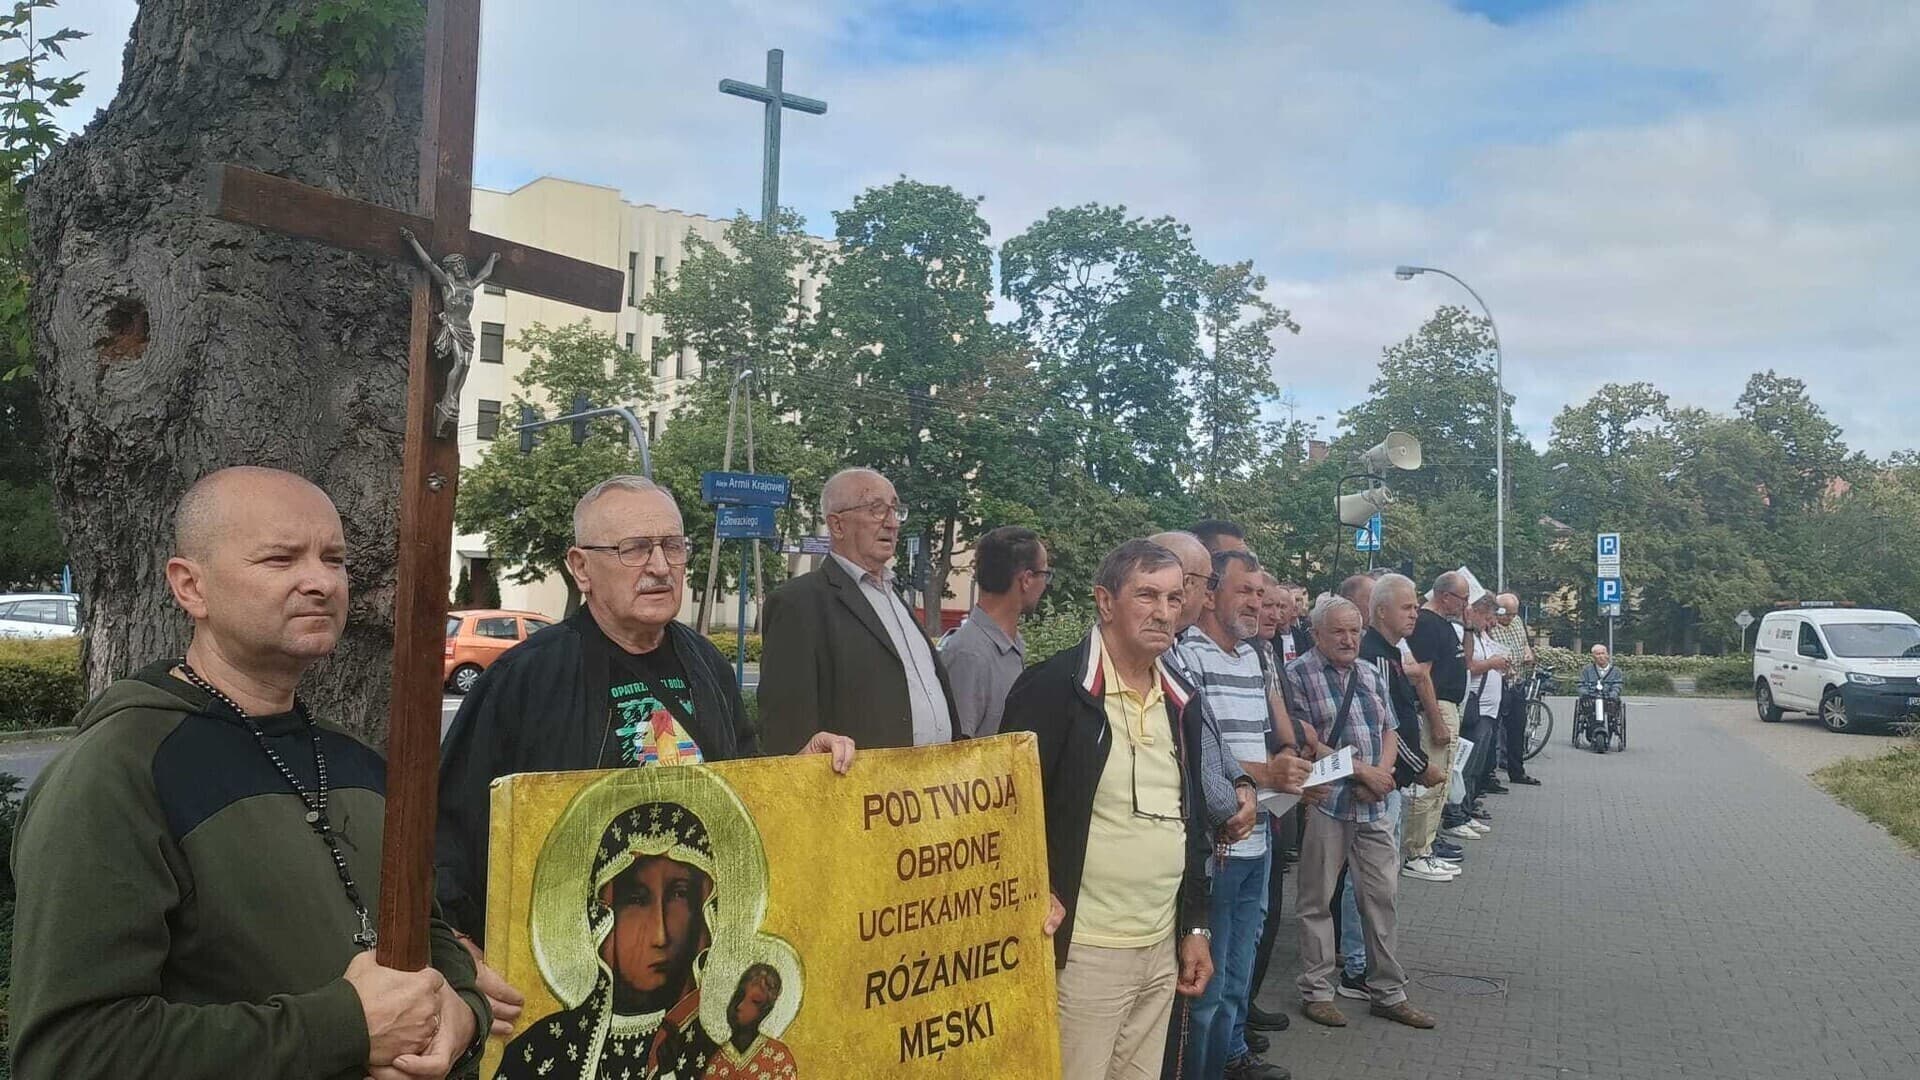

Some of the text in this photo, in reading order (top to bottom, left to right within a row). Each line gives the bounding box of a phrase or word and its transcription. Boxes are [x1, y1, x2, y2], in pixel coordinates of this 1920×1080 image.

[728, 478, 750, 489] Armii
[751, 480, 785, 494] Krajowej
[1603, 538, 1614, 553] P
[1603, 580, 1617, 601] P
[863, 774, 1018, 831] POD TWOJĄ
[896, 831, 1001, 882] OBRONĘ
[858, 885, 985, 942] UCIEKAMY
[864, 935, 1020, 1009] RÓŻANIEC
[899, 1001, 995, 1064] MĘSKI
